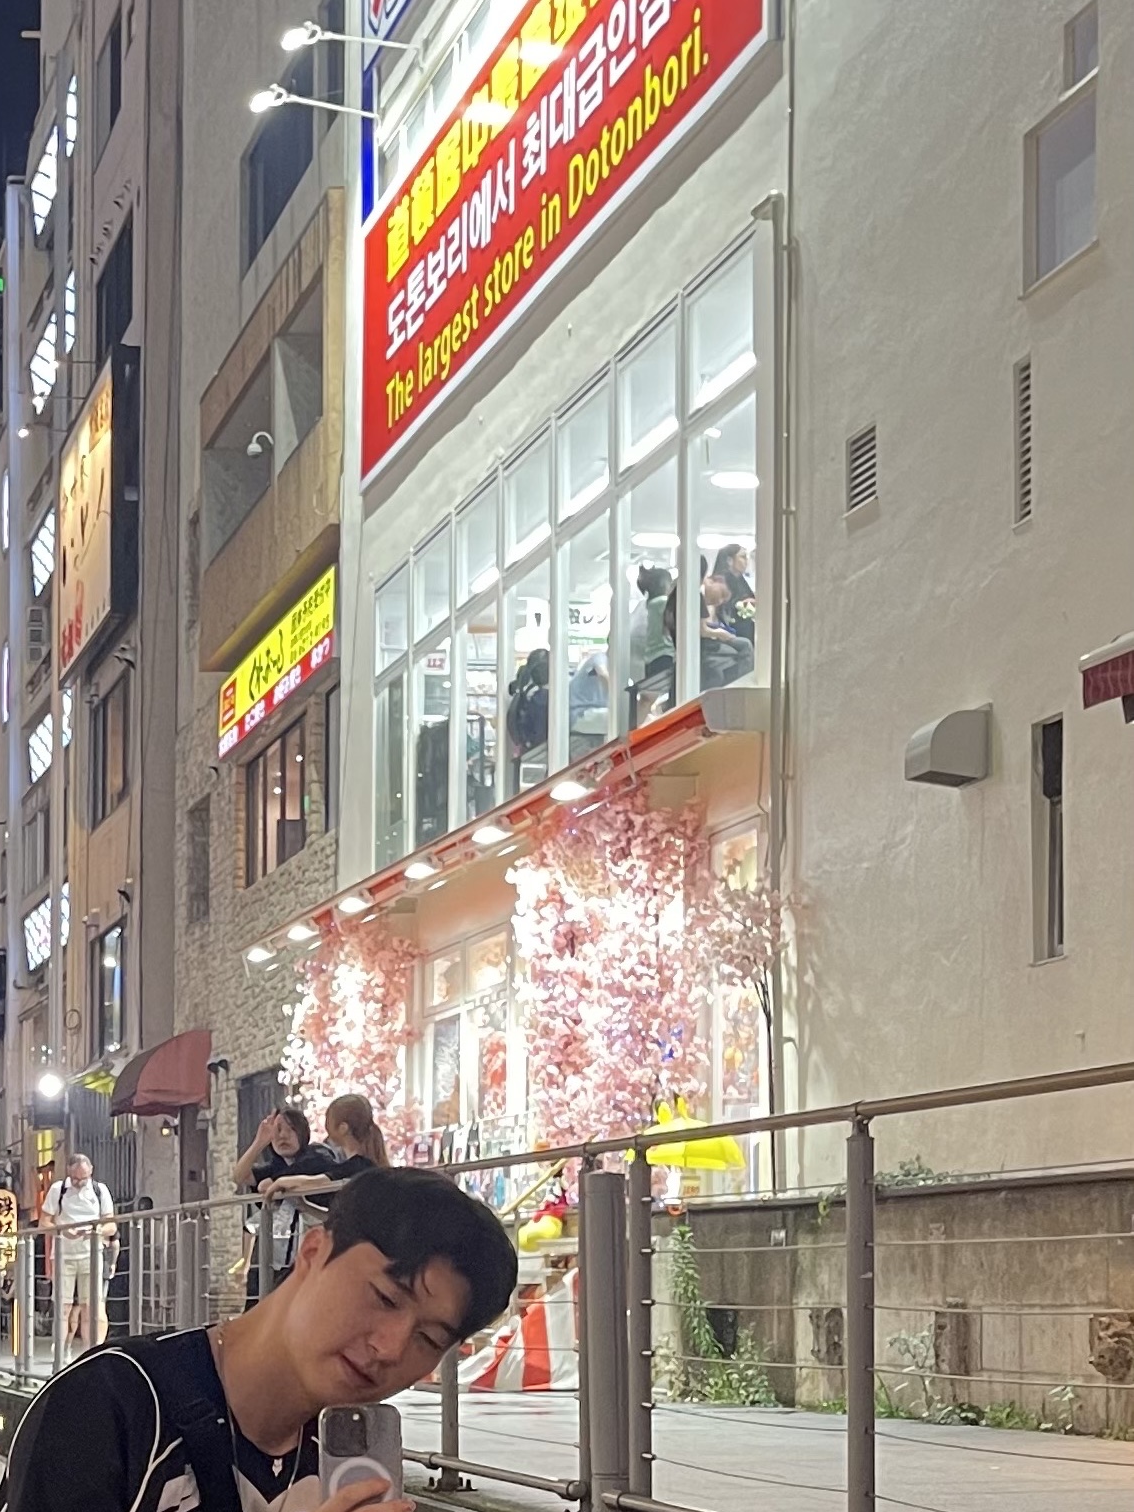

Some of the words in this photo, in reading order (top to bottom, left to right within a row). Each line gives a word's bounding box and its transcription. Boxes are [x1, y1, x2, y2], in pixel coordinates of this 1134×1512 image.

[385, 138, 515, 361] 도톤보리에서
[386, 369, 414, 429] The
[418, 283, 479, 394] largest
[484, 225, 535, 317] store
[541, 192, 561, 251] in
[568, 8, 709, 219] Dotonbori.
